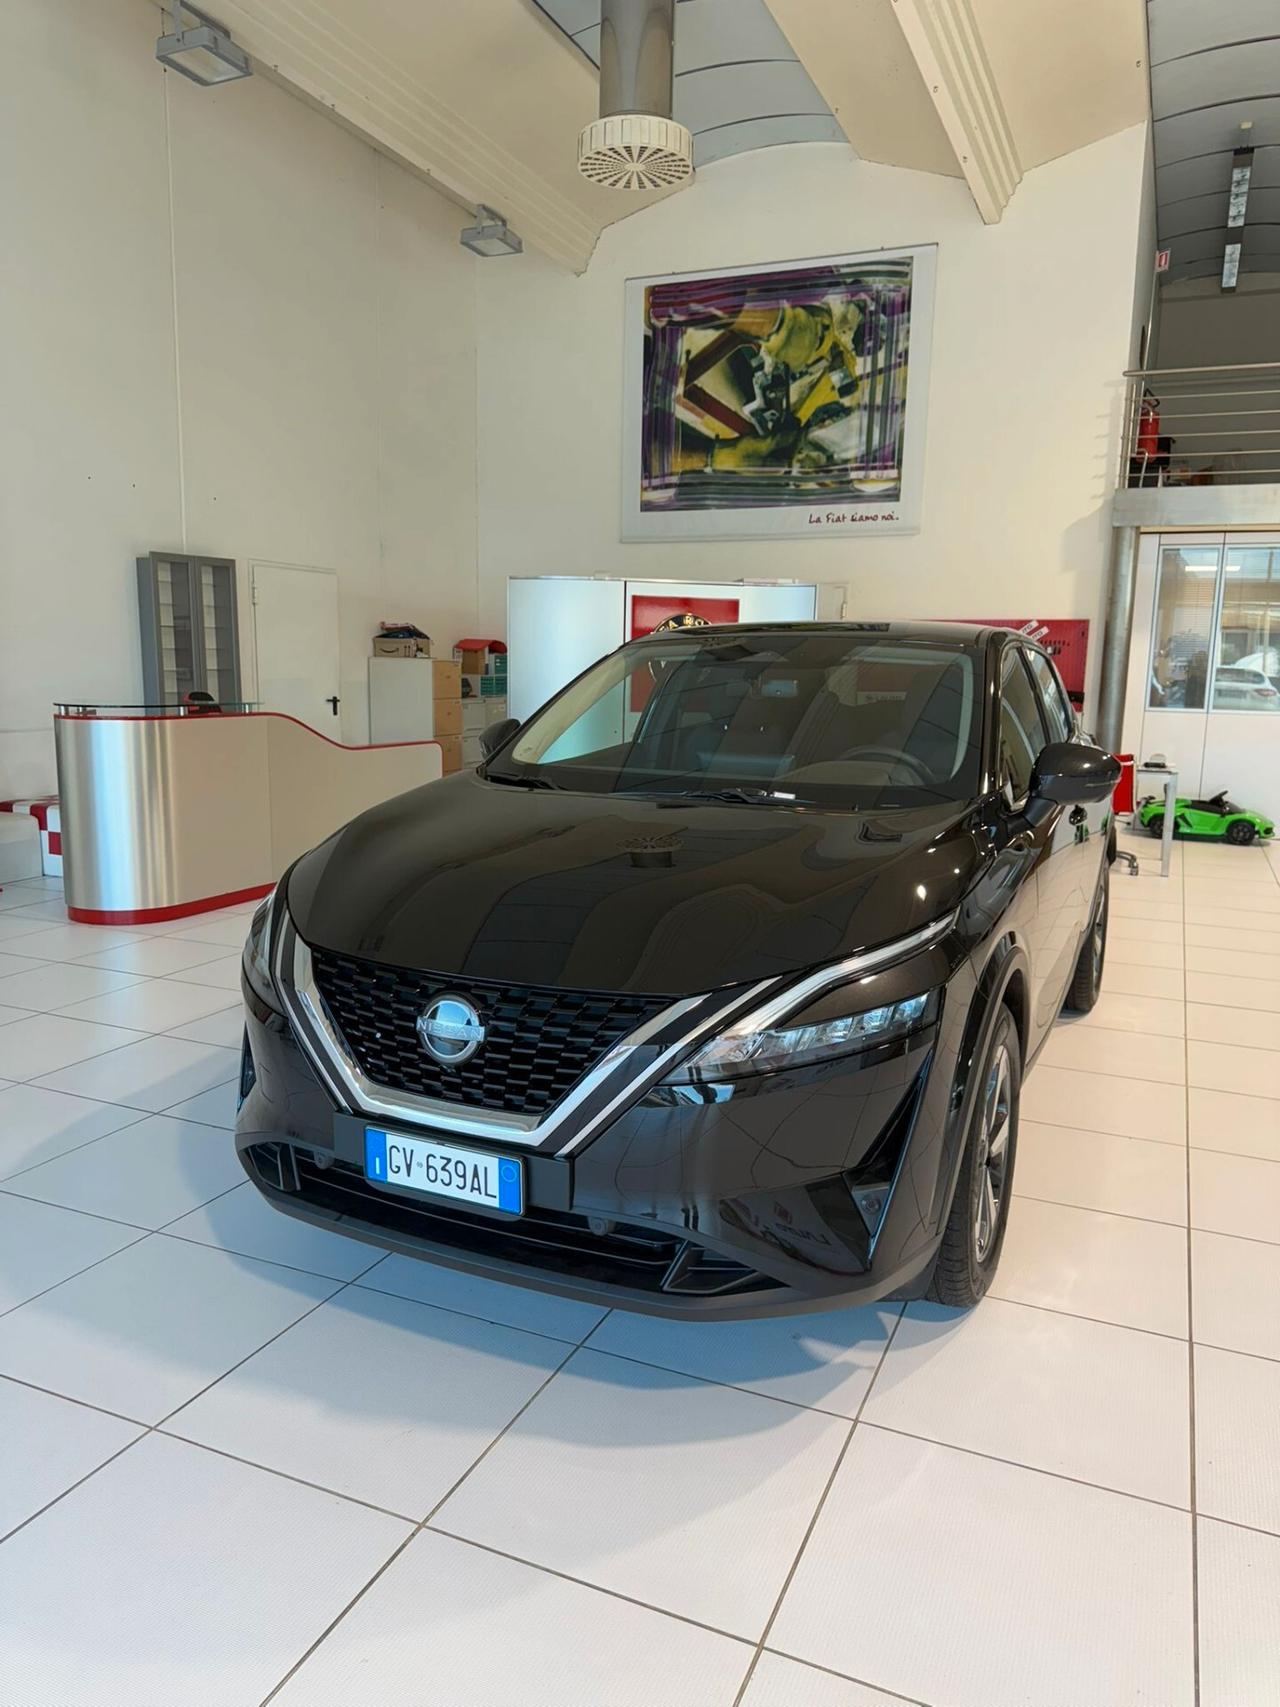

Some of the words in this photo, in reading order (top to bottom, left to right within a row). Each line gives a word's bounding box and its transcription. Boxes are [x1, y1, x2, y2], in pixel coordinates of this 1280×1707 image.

[808, 513, 821, 523] La
[826, 512, 846, 523] Fiat
[418, 1017, 482, 1040] NISSAN
[389, 1145, 414, 1178] GV
[426, 1153, 497, 1199] 639AL
